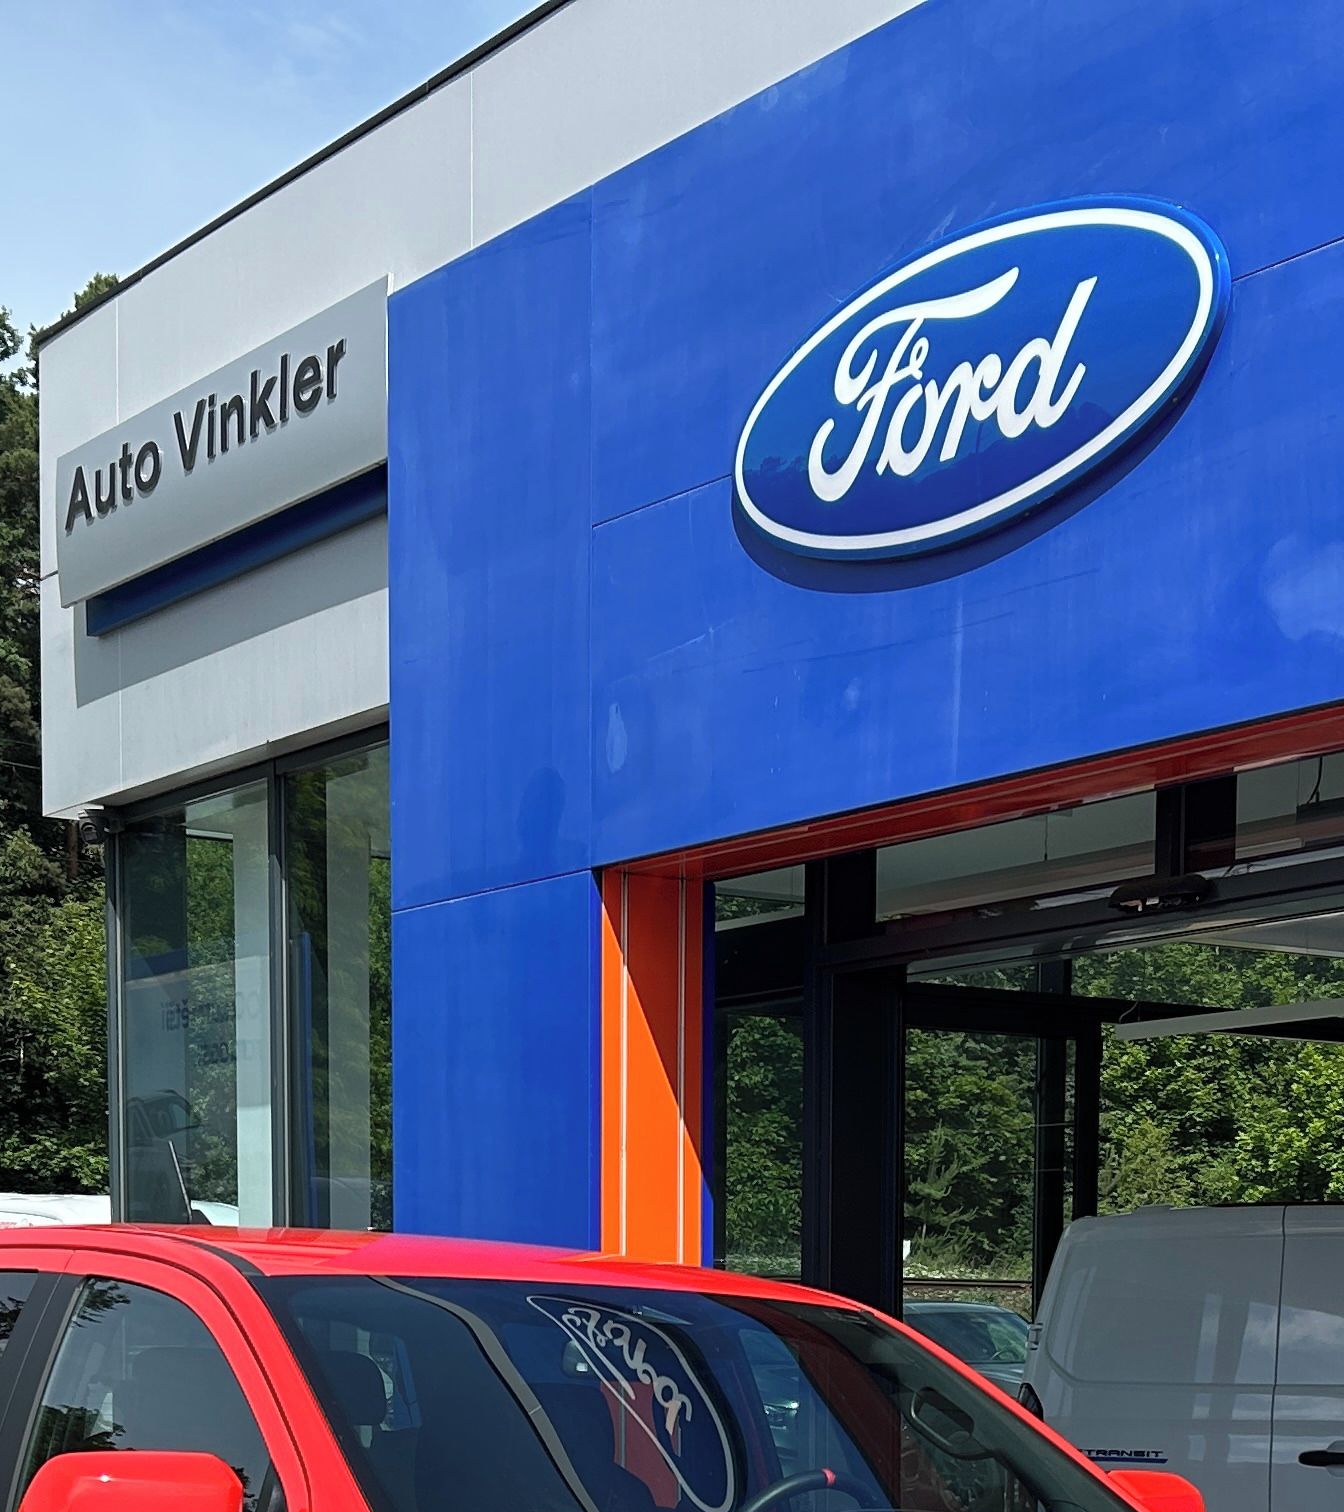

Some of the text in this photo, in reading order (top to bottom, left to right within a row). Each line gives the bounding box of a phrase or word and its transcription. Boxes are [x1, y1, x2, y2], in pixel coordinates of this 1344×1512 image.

[65, 338, 347, 534] Auto Vinkler
[808, 266, 1097, 502] Ford
